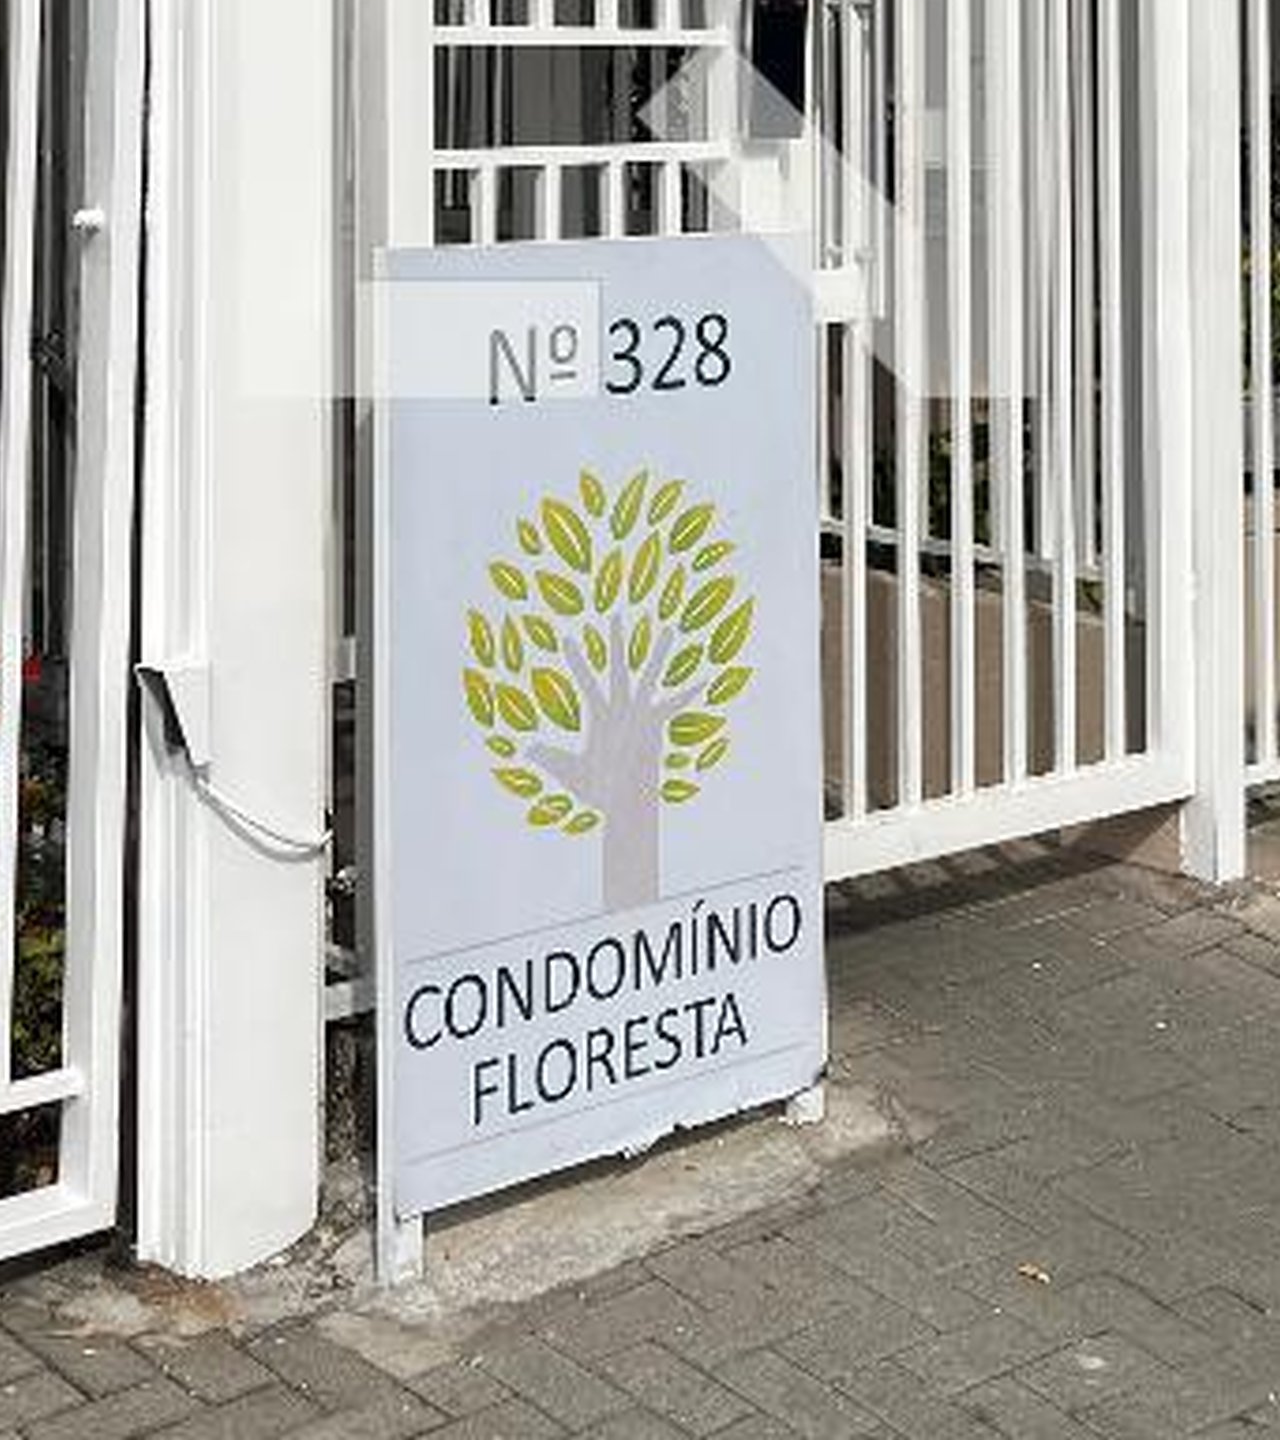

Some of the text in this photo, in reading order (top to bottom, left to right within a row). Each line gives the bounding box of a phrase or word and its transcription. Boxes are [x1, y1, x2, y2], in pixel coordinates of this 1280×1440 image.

[603, 312, 733, 398] 328
[403, 893, 803, 1053] CONDOMÍNIO
[470, 992, 750, 1127] FLORESTA
